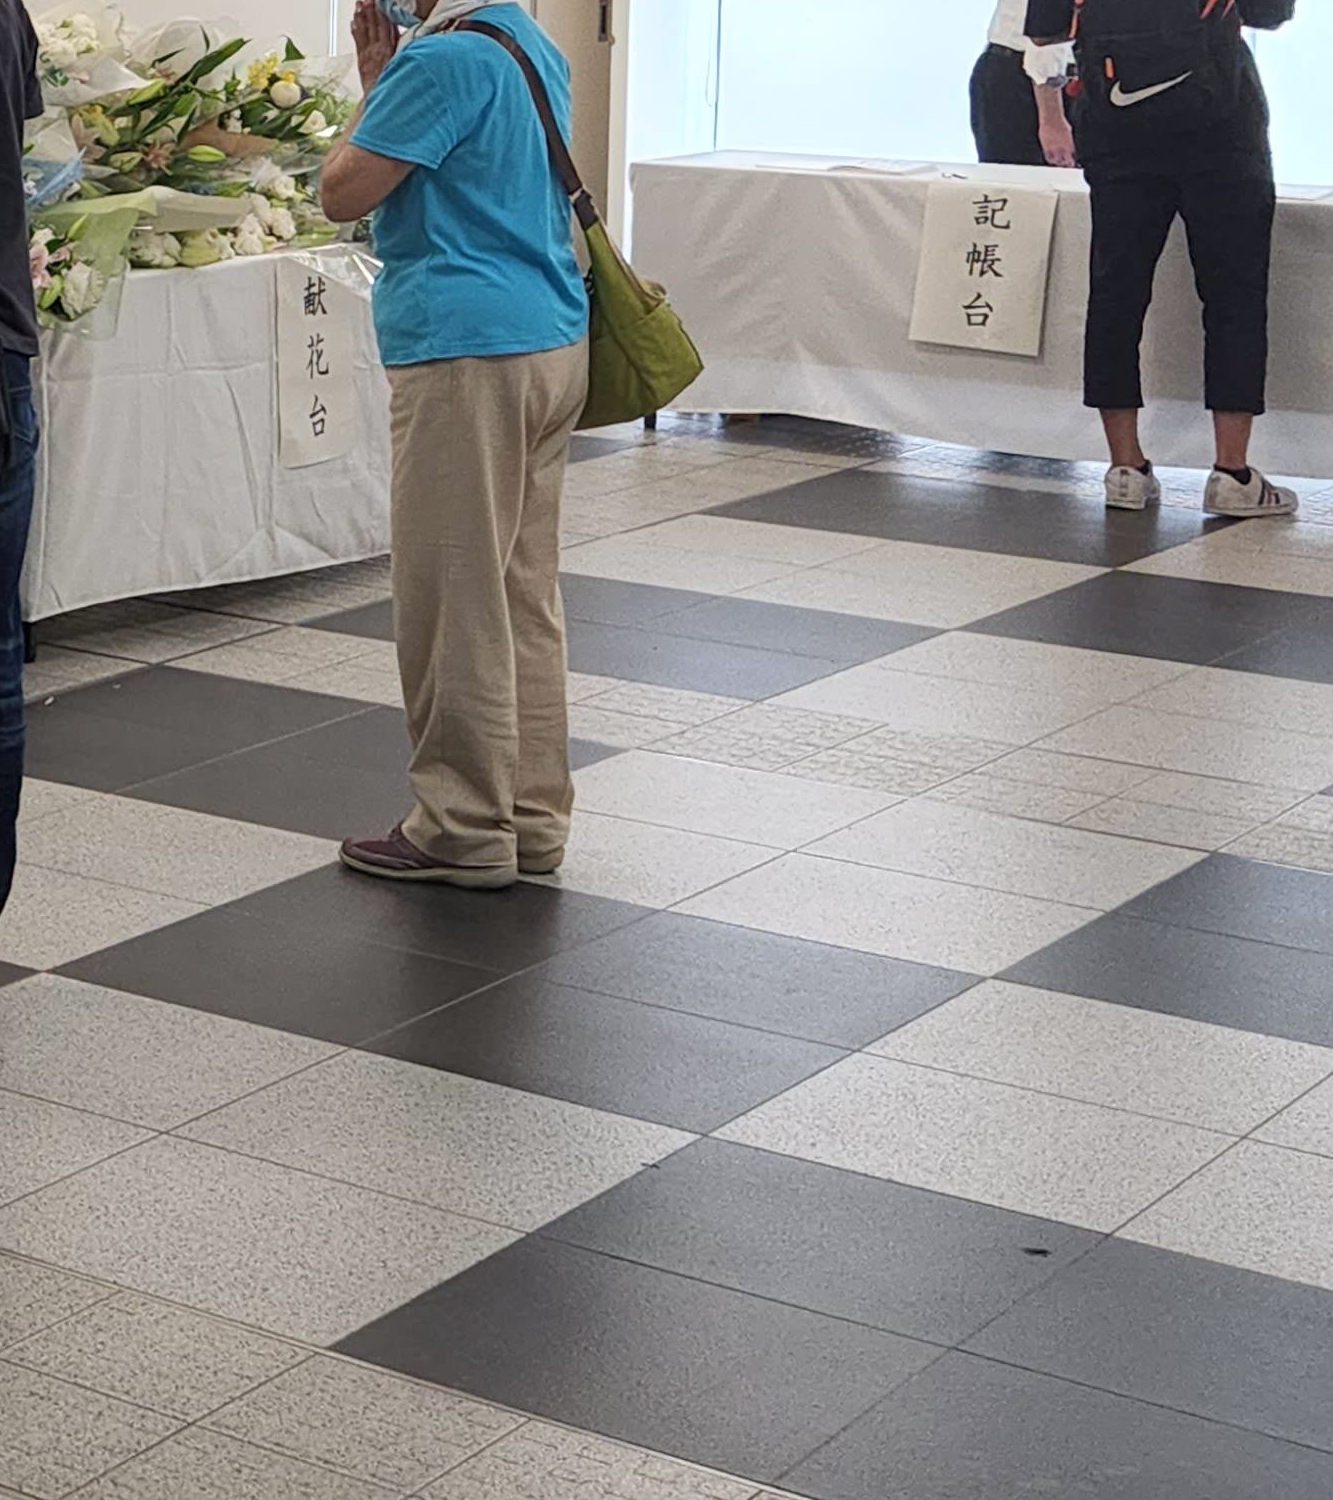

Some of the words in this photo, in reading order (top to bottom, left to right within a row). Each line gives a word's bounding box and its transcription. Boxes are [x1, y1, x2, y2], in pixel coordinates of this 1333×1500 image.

[962, 194, 1011, 327] 記帳台
[303, 276, 329, 437] 献花台
